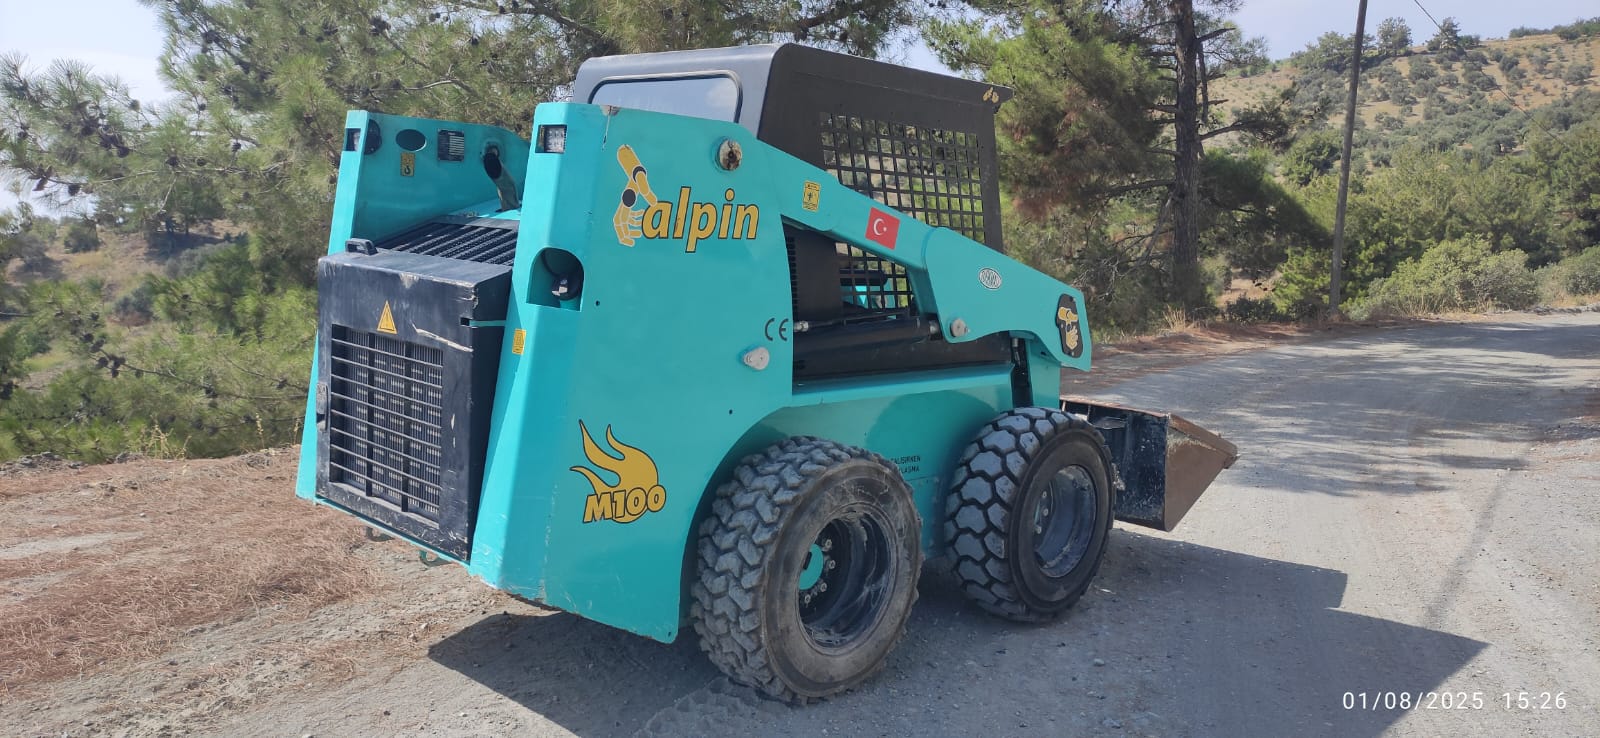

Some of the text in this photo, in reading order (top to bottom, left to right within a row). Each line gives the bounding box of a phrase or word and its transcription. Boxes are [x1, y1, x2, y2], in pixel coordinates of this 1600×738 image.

[641, 186, 759, 253] alpin
[765, 317, 789, 341] CE
[582, 484, 667, 523] M100
